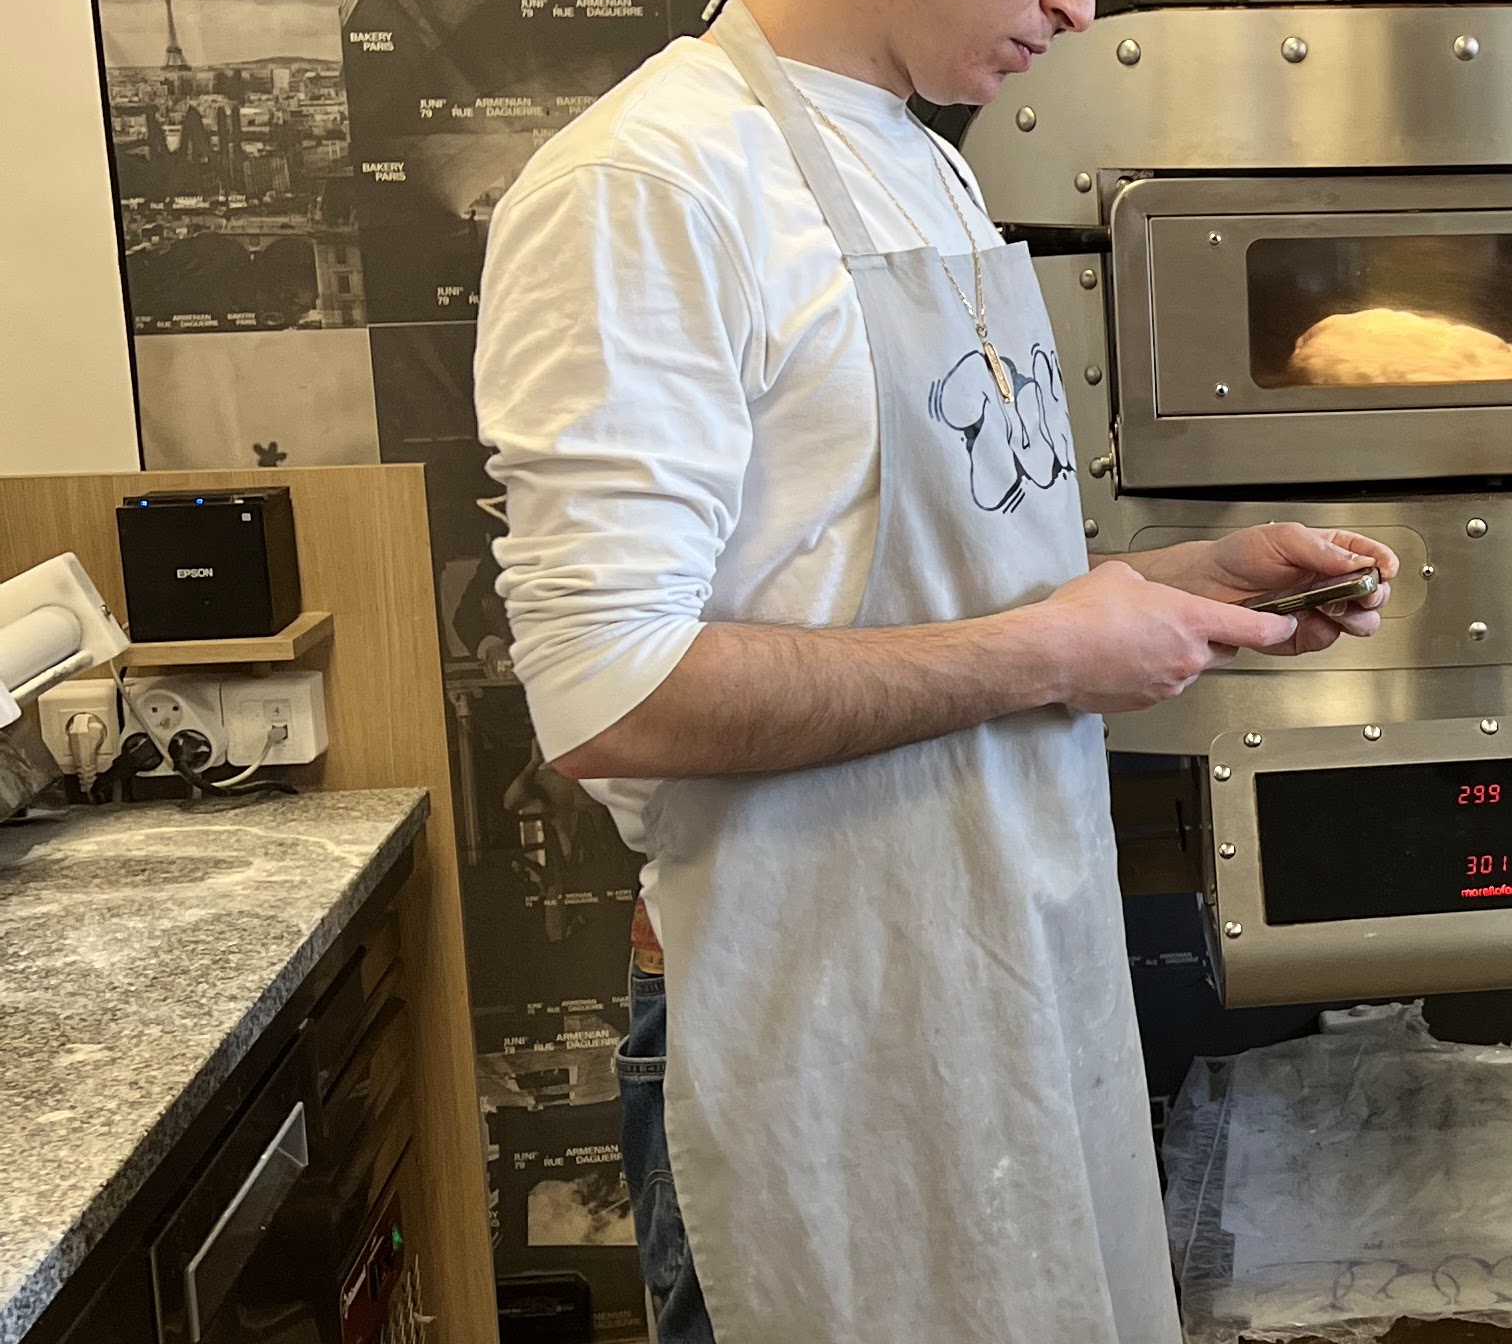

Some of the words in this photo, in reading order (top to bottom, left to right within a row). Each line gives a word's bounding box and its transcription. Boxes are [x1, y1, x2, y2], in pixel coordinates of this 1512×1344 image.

[553, 7, 575, 17] RUE
[586, 7, 644, 17] DAGUERRE
[350, 32, 393, 43] BAKERY
[363, 42, 394, 52] PARIS
[362, 162, 404, 173] BAKERY
[375, 172, 406, 182] PARIS
[176, 567, 214, 579] EPSON
[1457, 783, 1502, 805] 299
[1465, 855, 1508, 875] 301
